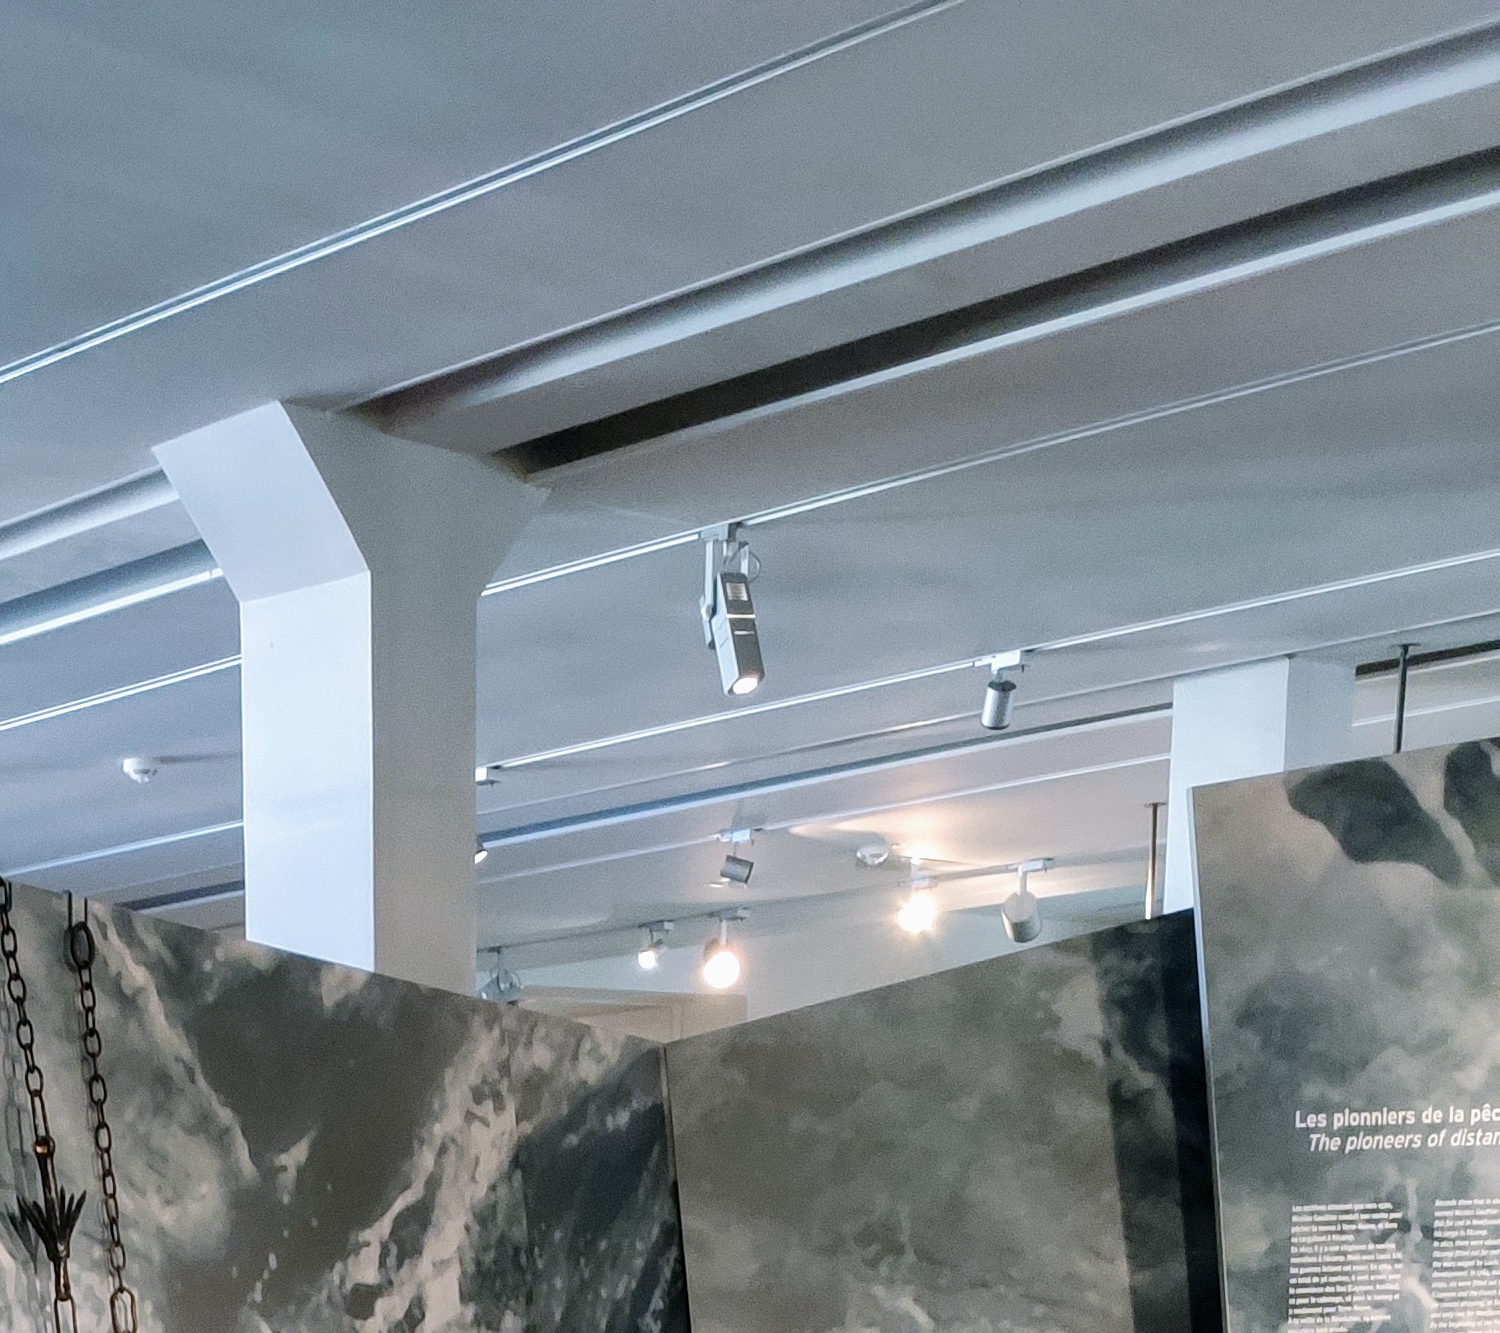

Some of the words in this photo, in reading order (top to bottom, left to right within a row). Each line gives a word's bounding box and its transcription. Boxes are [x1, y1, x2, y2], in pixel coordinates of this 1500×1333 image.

[1295, 1109, 1328, 1129] Les
[1333, 1106, 1416, 1131] pionniers
[1422, 1105, 1443, 1124] de
[1449, 1105, 1465, 1123] la
[1309, 1132, 1342, 1152] The
[1345, 1131, 1423, 1154] pioneers
[1427, 1128, 1447, 1148] of
